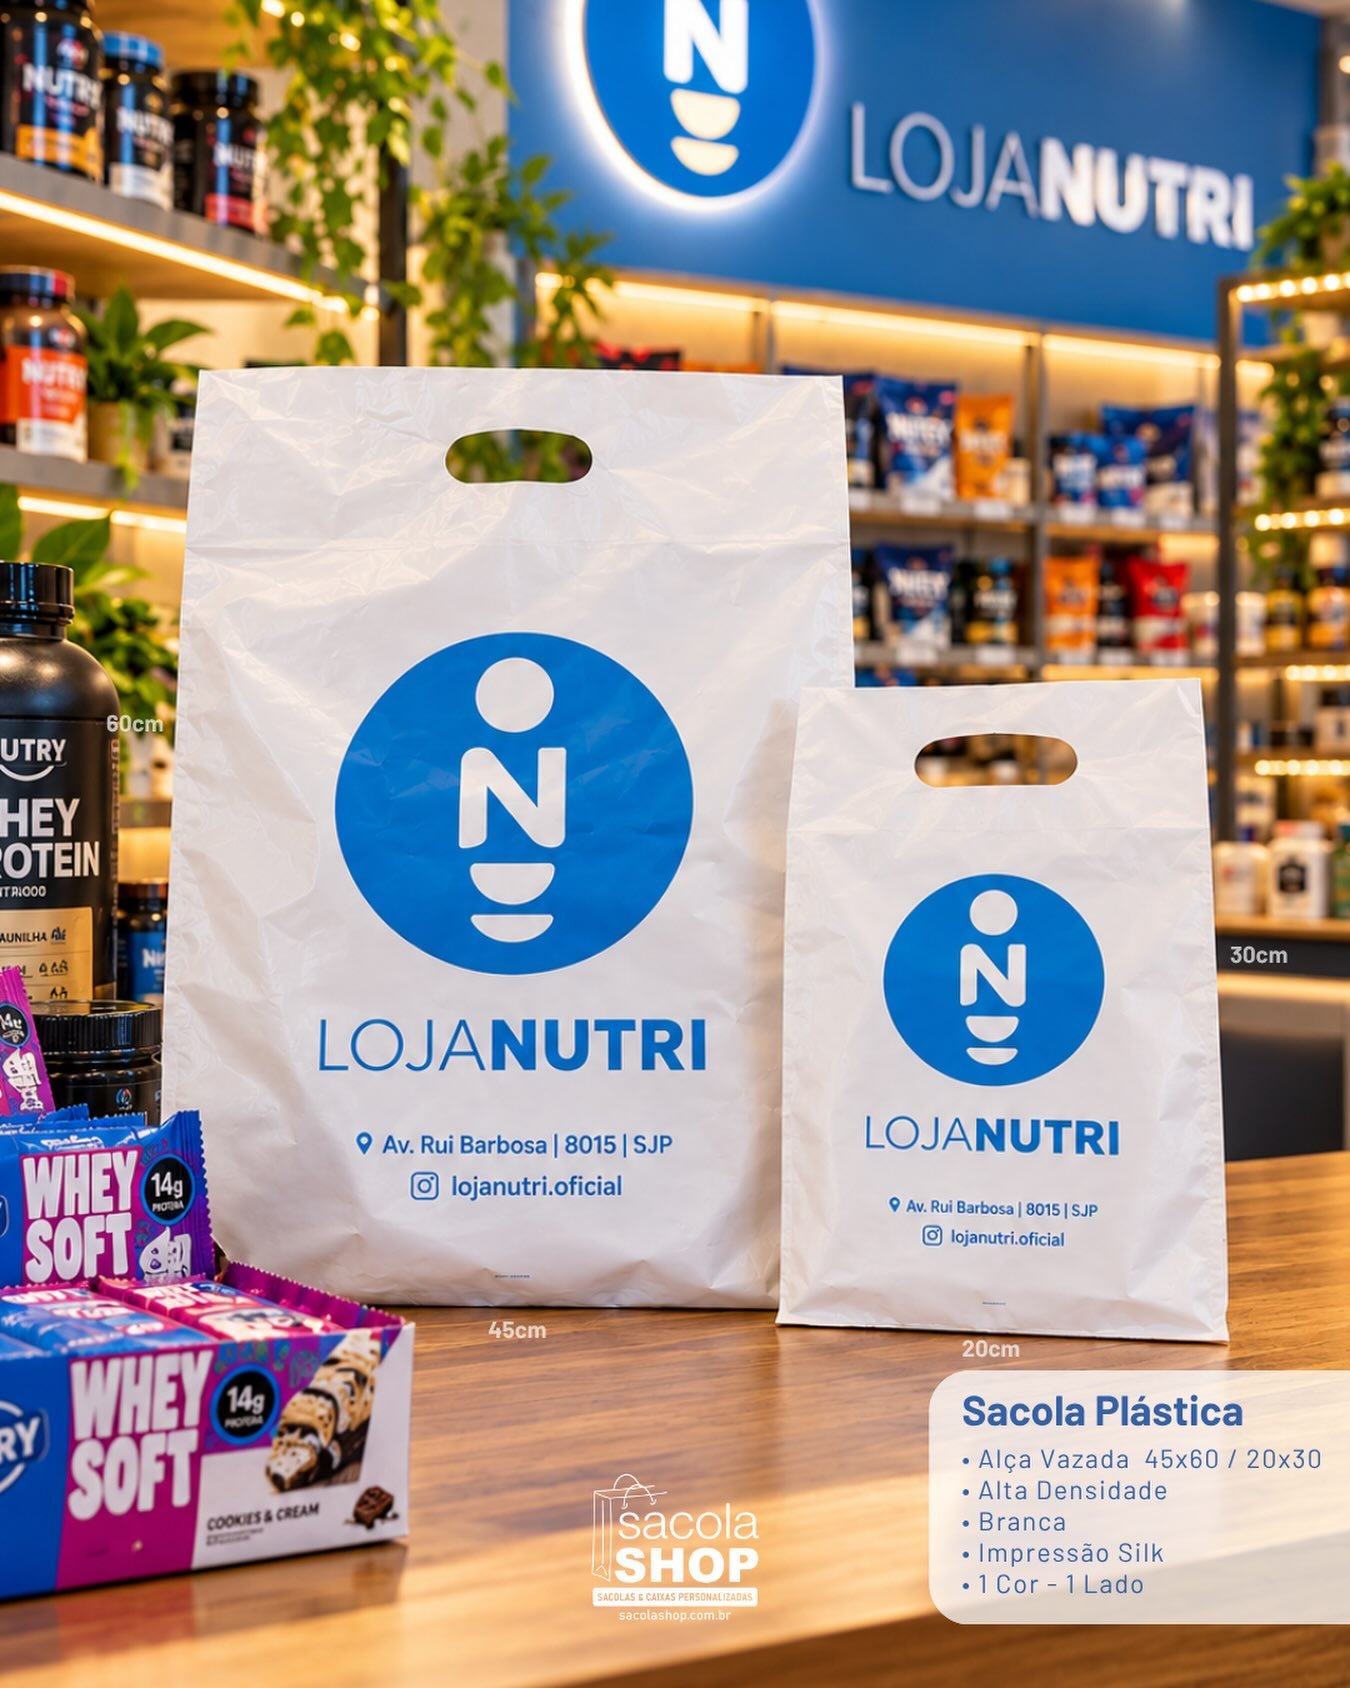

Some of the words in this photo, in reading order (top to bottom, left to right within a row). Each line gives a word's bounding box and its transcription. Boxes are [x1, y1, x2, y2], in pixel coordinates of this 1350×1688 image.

[663, 0, 749, 94] N
[850, 102, 1255, 250] LOJANUTRI
[459, 747, 567, 849] N
[0, 841, 100, 879] OTEIN
[960, 943, 1027, 1007] N
[319, 1018, 707, 1073] LOJANUTRI
[382, 1135, 414, 1154] Av.
[420, 1134, 454, 1154] Rui
[459, 1134, 548, 1155] Barbosa
[564, 1134, 617, 1155] 8015
[632, 1134, 673, 1154] SJP
[865, 1115, 1121, 1157] LOJANUTRI
[23, 1150, 138, 1220] WHEY
[151, 1171, 183, 1199] 14g
[451, 1174, 623, 1201] lojanutri.oficial
[906, 1199, 927, 1213] Av.
[930, 1199, 953, 1214] Rui
[956, 1199, 1014, 1216] Barbosa
[1026, 1202, 1061, 1217] 8015
[1071, 1203, 1099, 1217] SJP
[25, 1212, 132, 1283] SOFT
[950, 1229, 1065, 1247] lojanutri.oficial
[70, 1349, 214, 1441] WHEY
[226, 1384, 266, 1415] 14g
[67, 1429, 199, 1521] SOFT
[207, 1511, 262, 1531] COOKIES
[276, 1502, 320, 1522] CREAM
